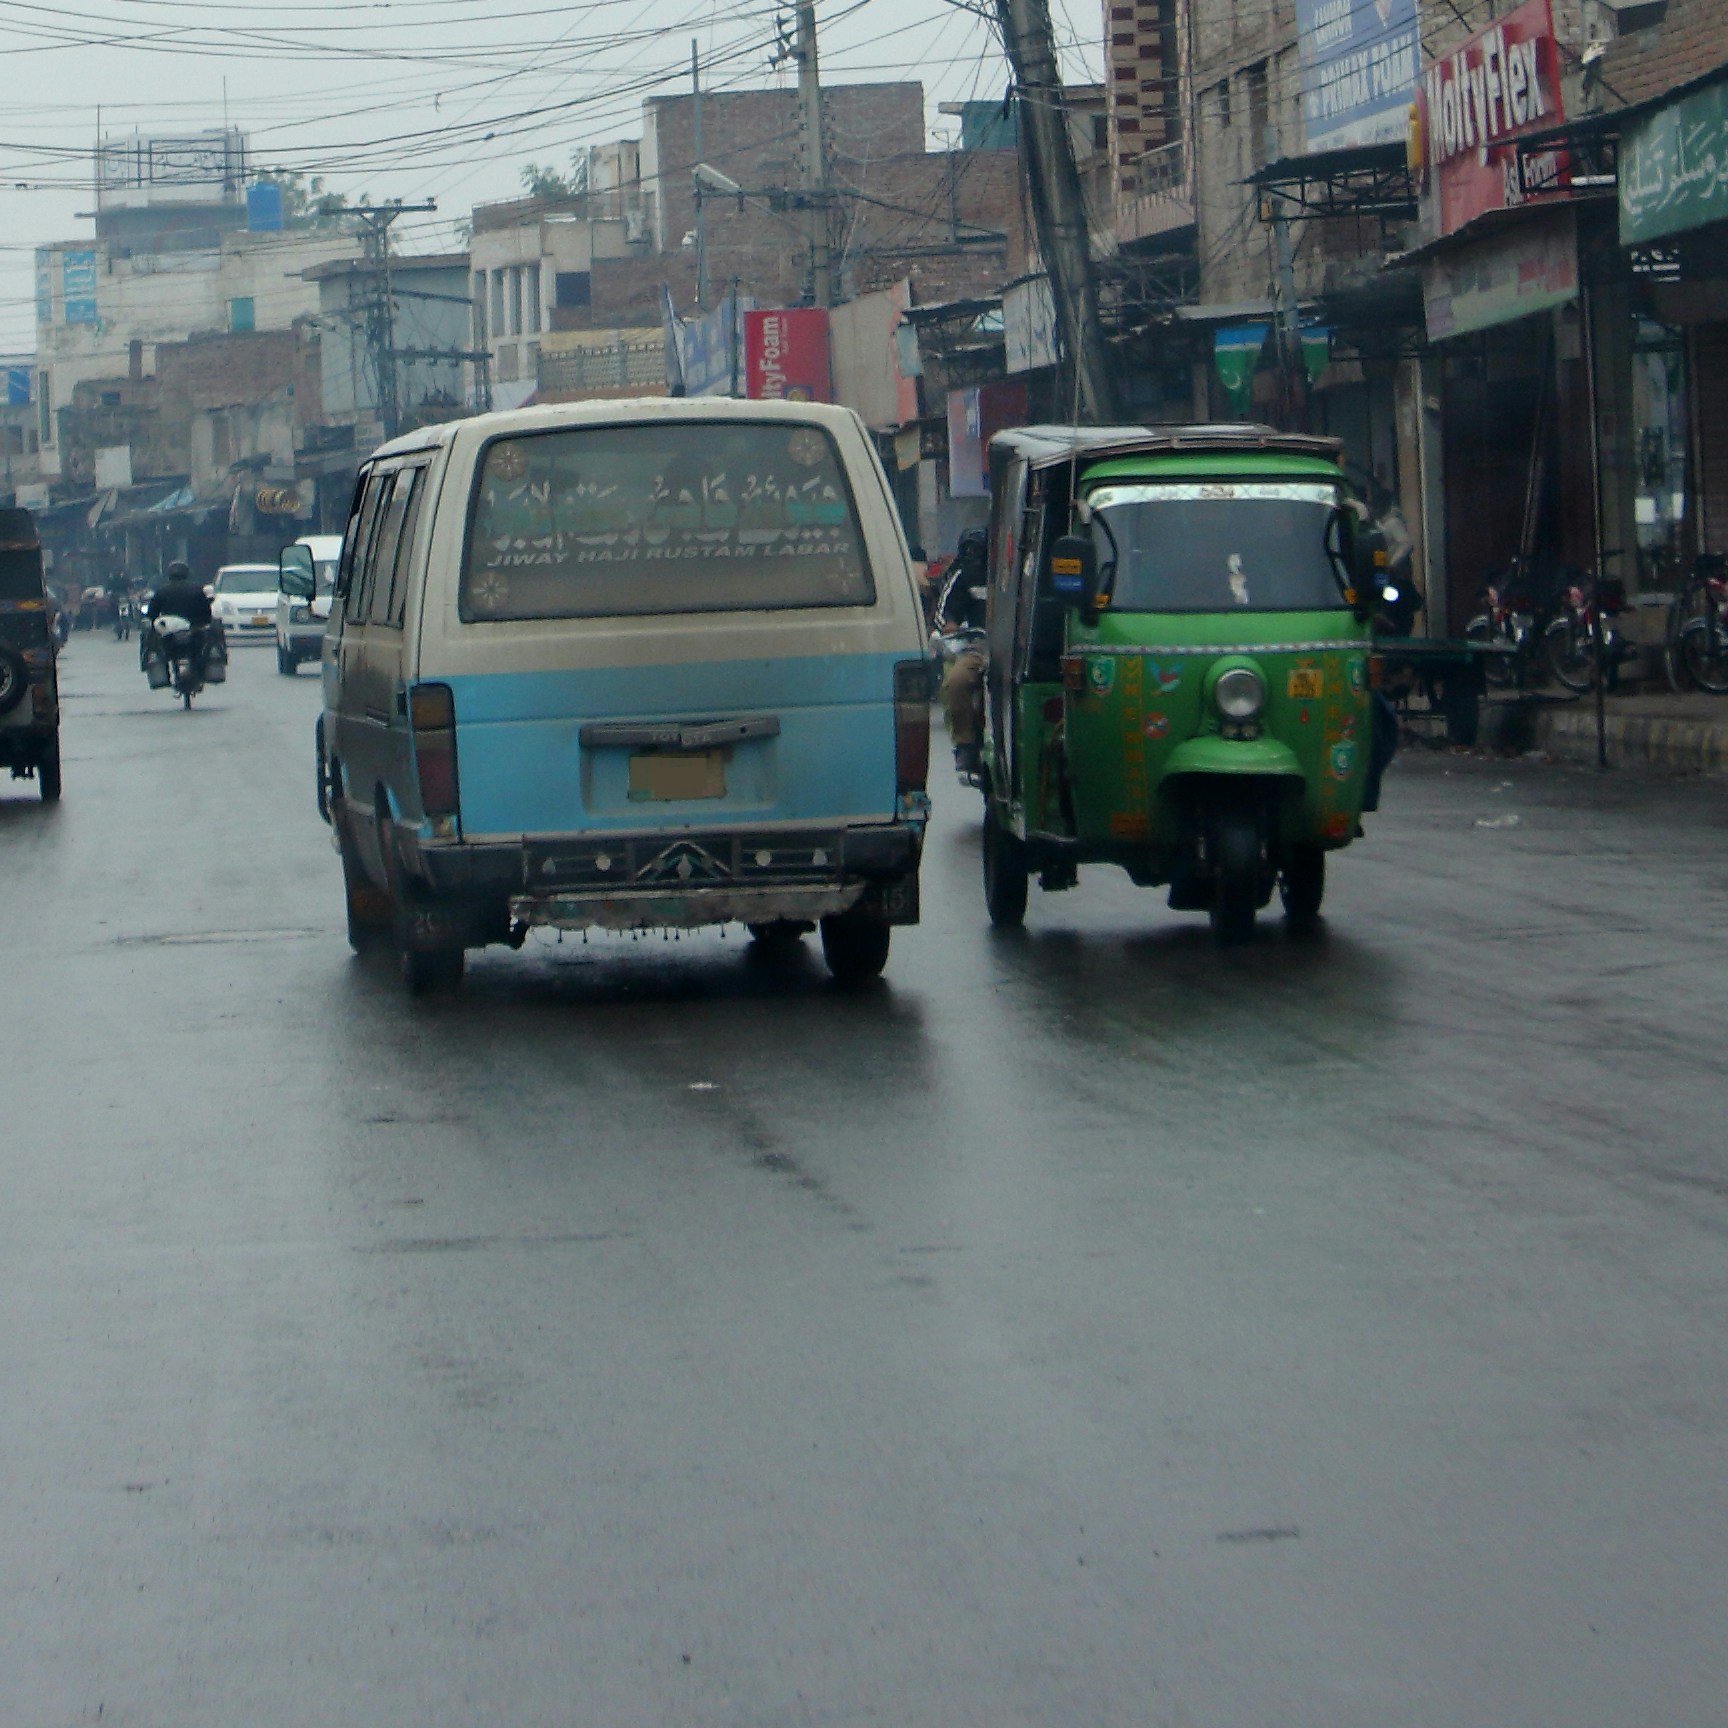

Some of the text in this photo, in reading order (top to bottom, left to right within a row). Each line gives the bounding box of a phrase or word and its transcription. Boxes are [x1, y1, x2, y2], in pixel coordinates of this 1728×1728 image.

[1426, 25, 1546, 167] MoltyFlex
[486, 551, 568, 568] JIWAY
[577, 548, 640, 563] HAJI
[646, 545, 755, 560] RUSTAM
